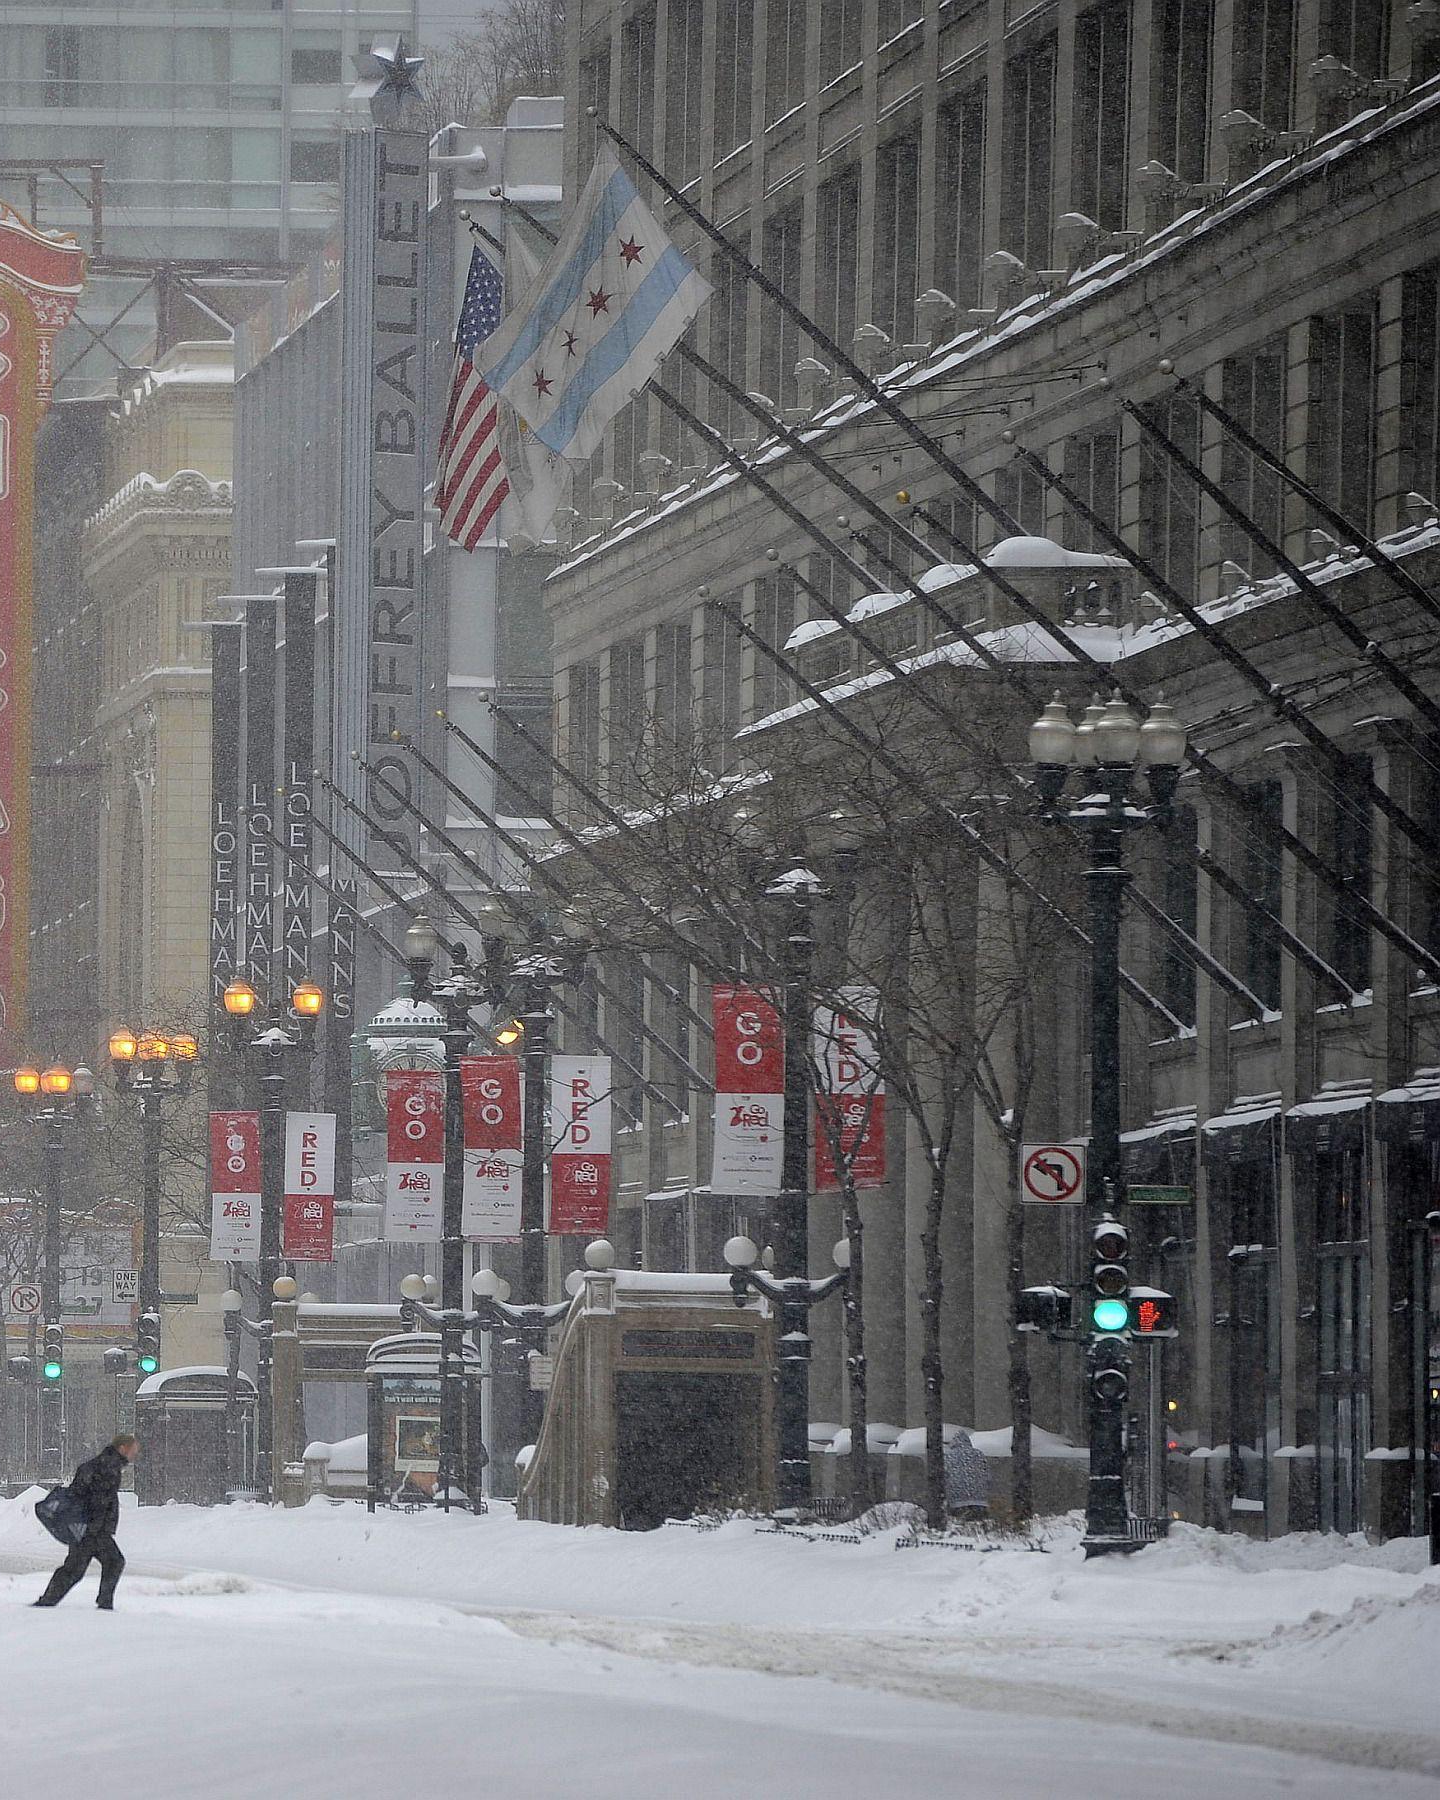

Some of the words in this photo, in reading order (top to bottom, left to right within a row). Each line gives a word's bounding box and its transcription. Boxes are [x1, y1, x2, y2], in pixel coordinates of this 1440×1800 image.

[375, 142, 421, 455] BALLET
[369, 486, 415, 867] JOFFREY
[736, 1011, 763, 1066] GO
[405, 1096, 426, 1140] GO
[481, 1079, 504, 1125] GO
[571, 1078, 591, 1145] RED
[301, 1132, 318, 1187] RED
[575, 1168, 598, 1183] Red
[115, 1281, 137, 1290] WAY
[116, 1272, 137, 1281] ONE
